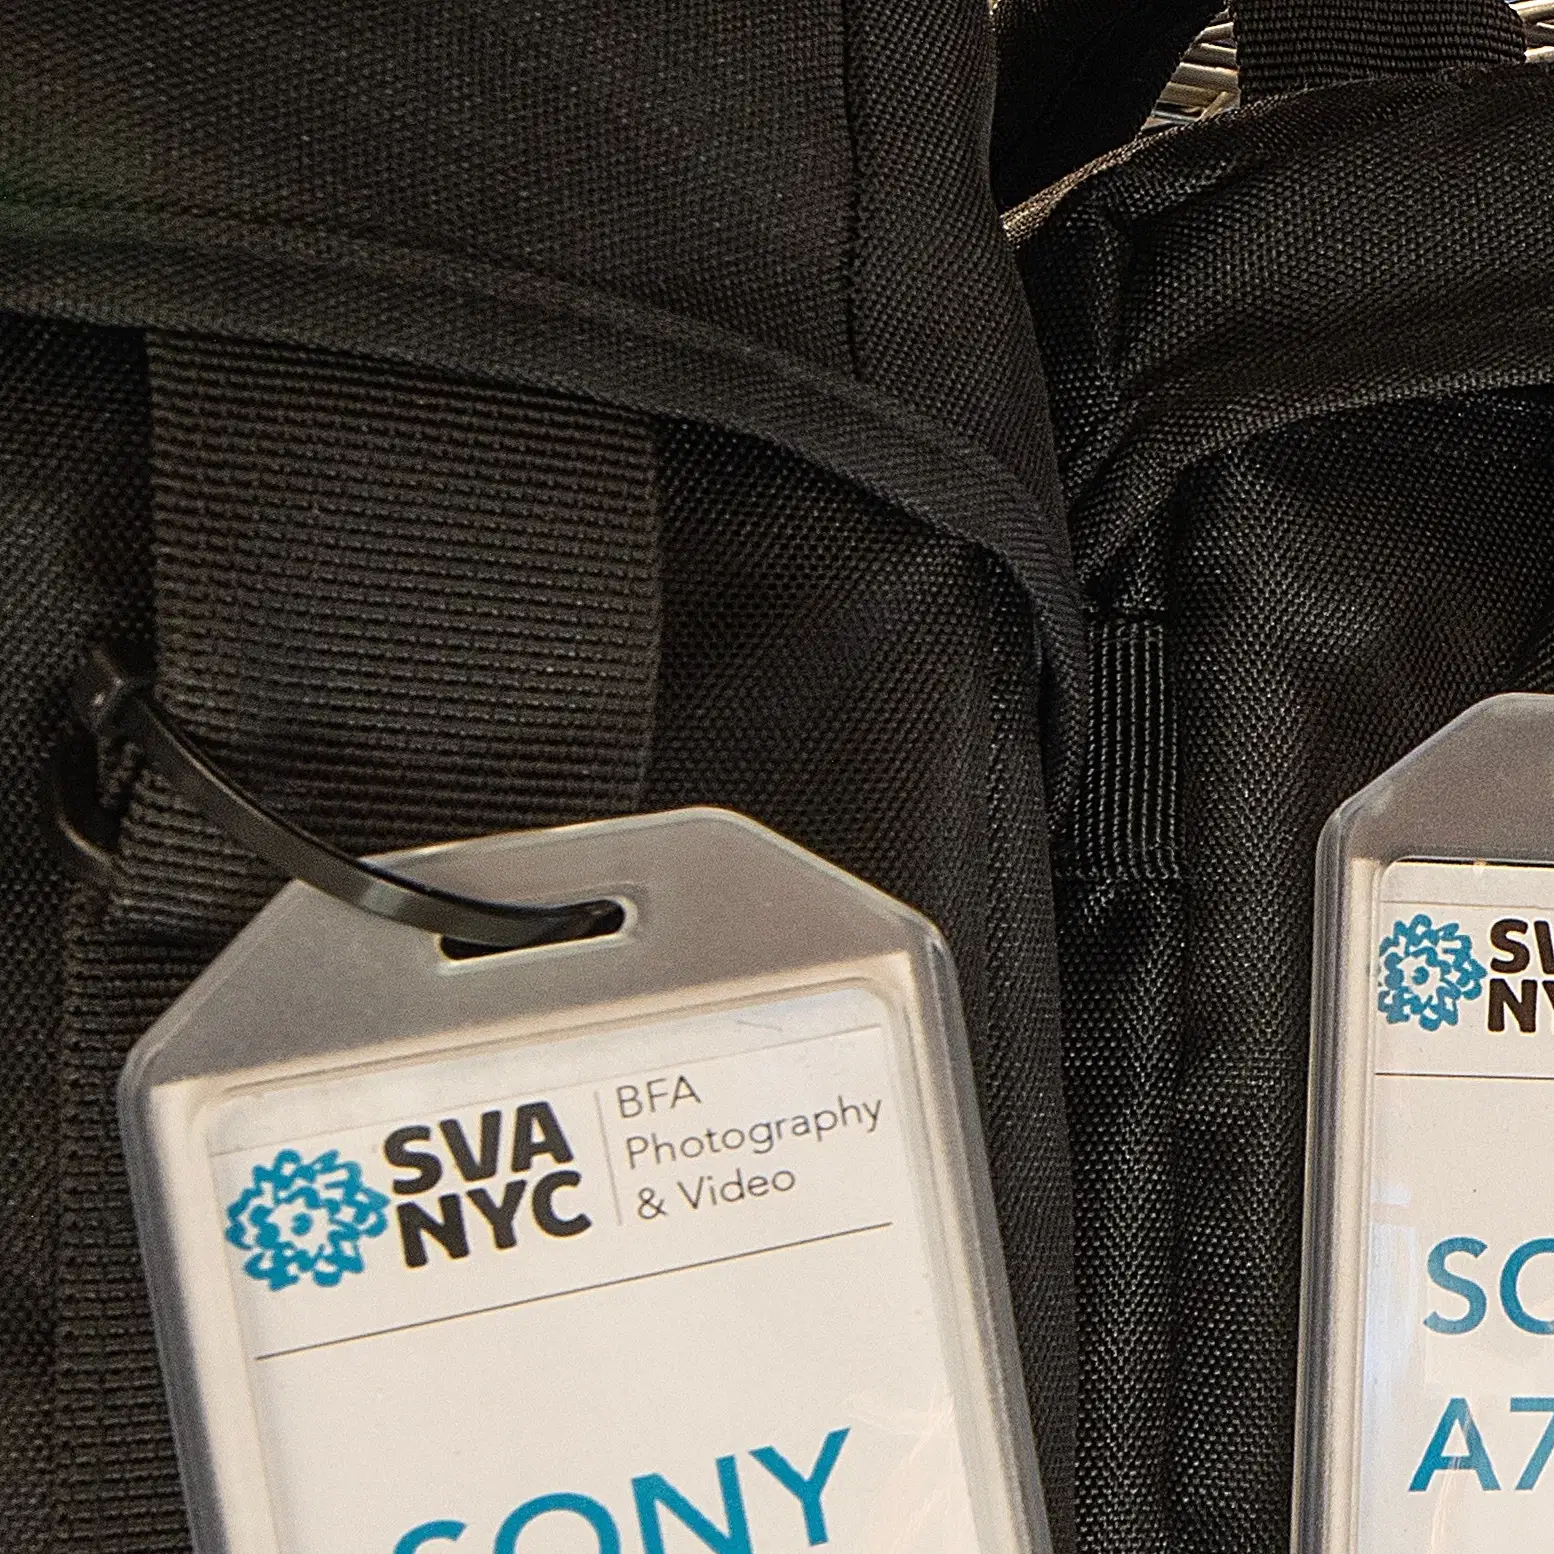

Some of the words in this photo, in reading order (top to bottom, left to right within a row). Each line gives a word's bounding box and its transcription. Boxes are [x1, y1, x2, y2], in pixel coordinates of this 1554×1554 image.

[615, 1074, 701, 1120] BFA
[624, 1096, 883, 1170] Photography
[383, 1100, 574, 1196] SVA
[396, 1170, 592, 1269] NYC
[636, 1188, 666, 1221] &
[676, 1165, 797, 1212] Video
